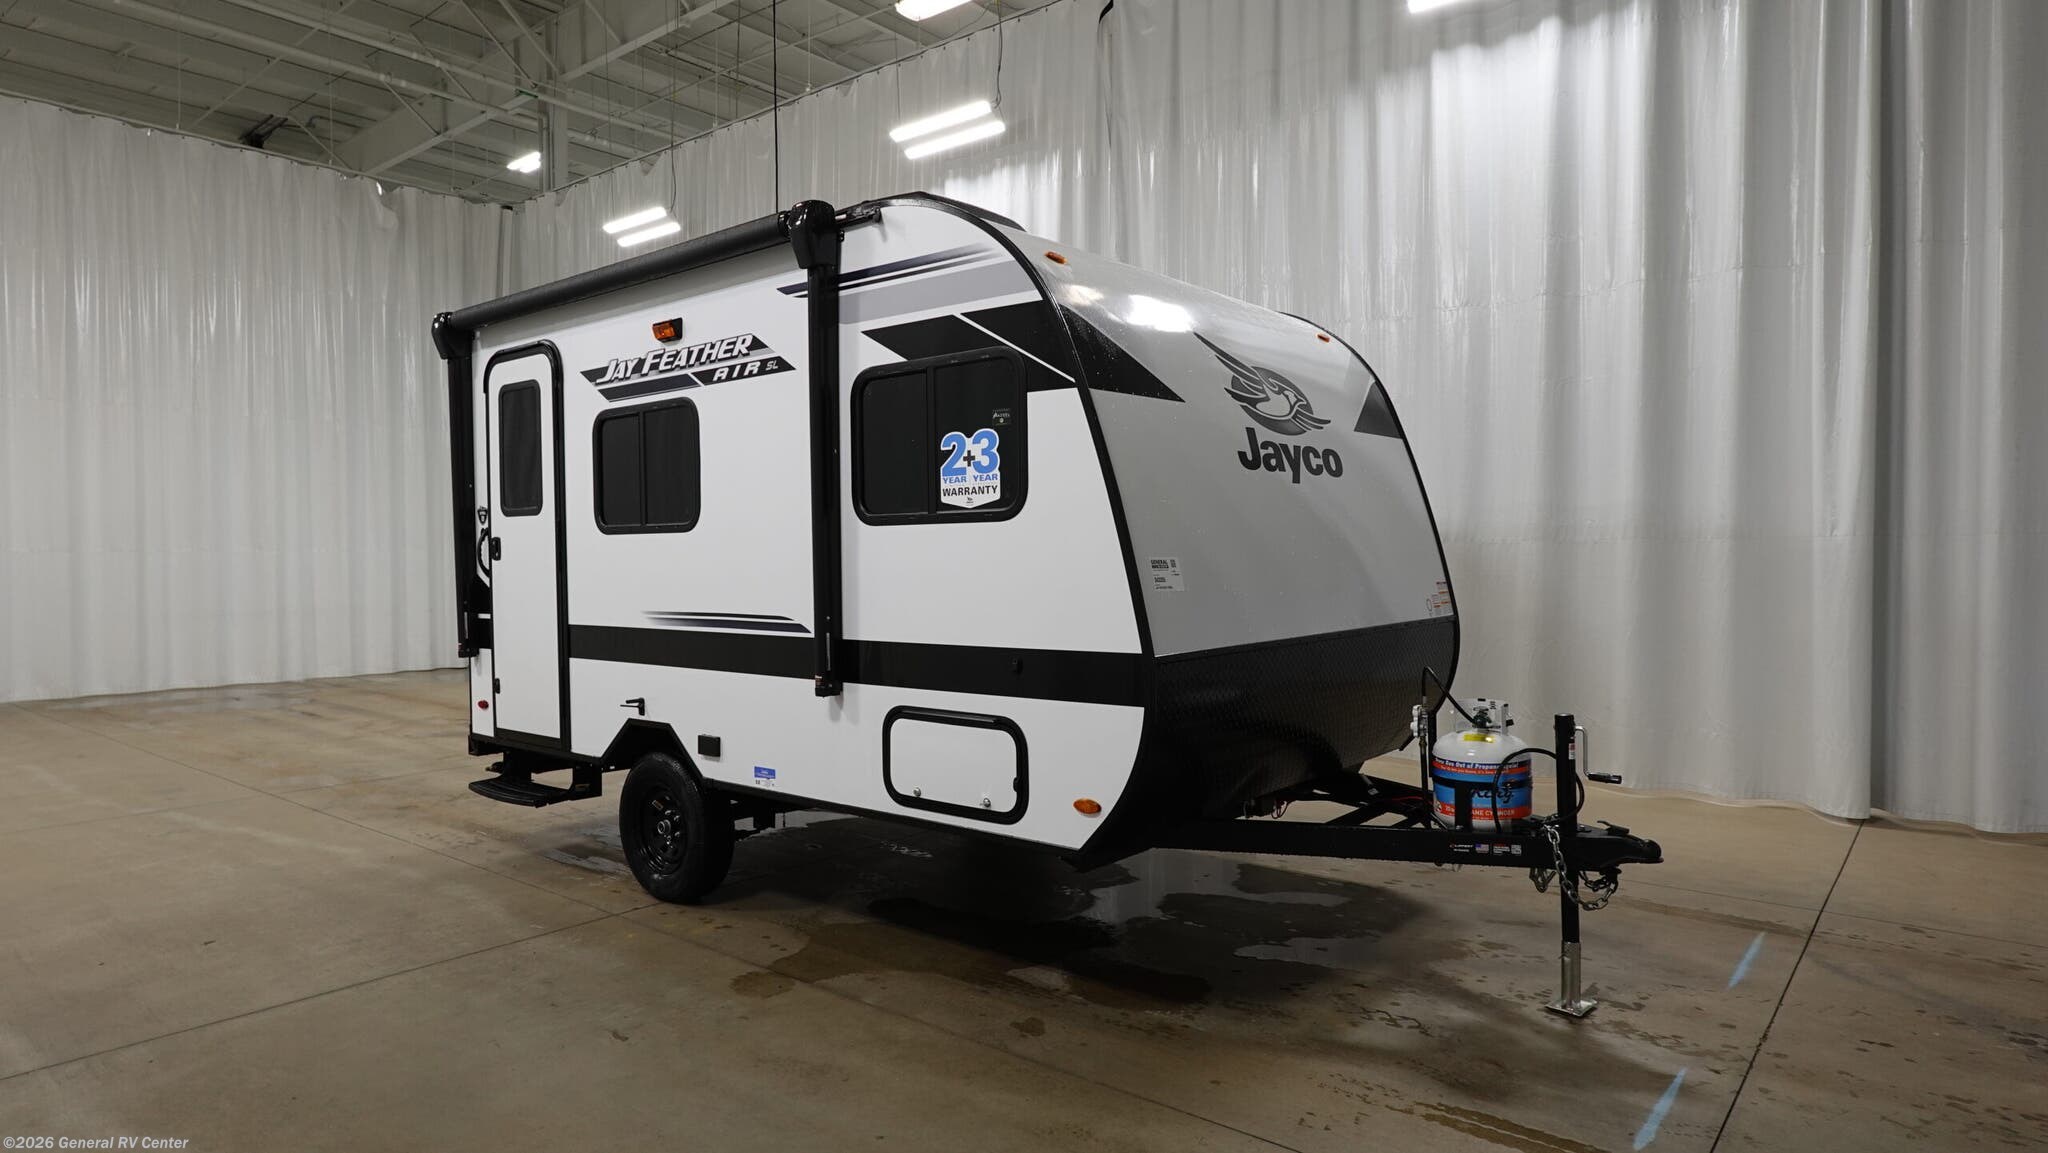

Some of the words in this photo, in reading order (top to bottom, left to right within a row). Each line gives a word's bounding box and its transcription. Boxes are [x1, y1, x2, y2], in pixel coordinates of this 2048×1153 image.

[596, 358, 641, 384] JAY
[641, 333, 754, 377] FEATHER
[712, 361, 761, 382] AIR
[765, 360, 779, 371] SL
[1237, 426, 1344, 484] Jayco
[942, 476, 967, 484] YEAR
[973, 474, 998, 482] YEAR
[942, 485, 998, 497] WARRANTY
